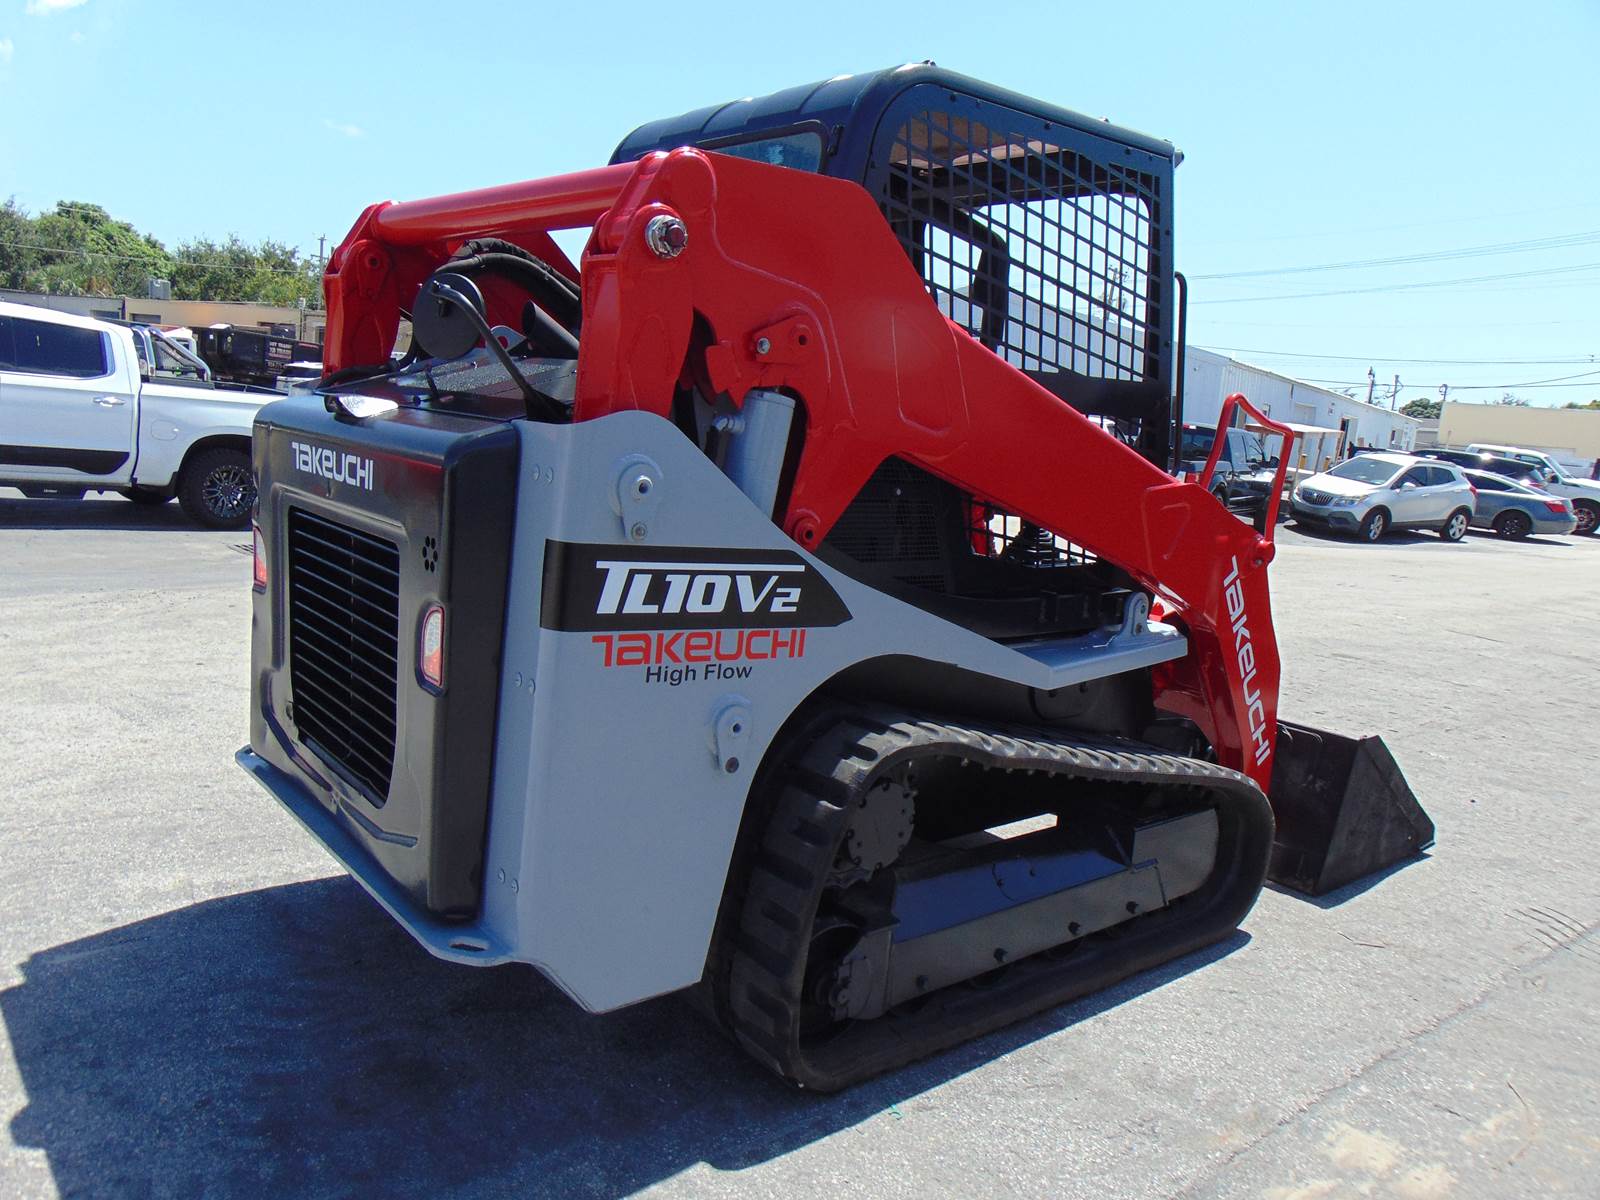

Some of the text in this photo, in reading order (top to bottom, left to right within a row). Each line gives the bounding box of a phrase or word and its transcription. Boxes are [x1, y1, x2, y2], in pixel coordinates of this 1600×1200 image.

[596, 560, 806, 614] TL10V2
[645, 663, 753, 687] High Flow
